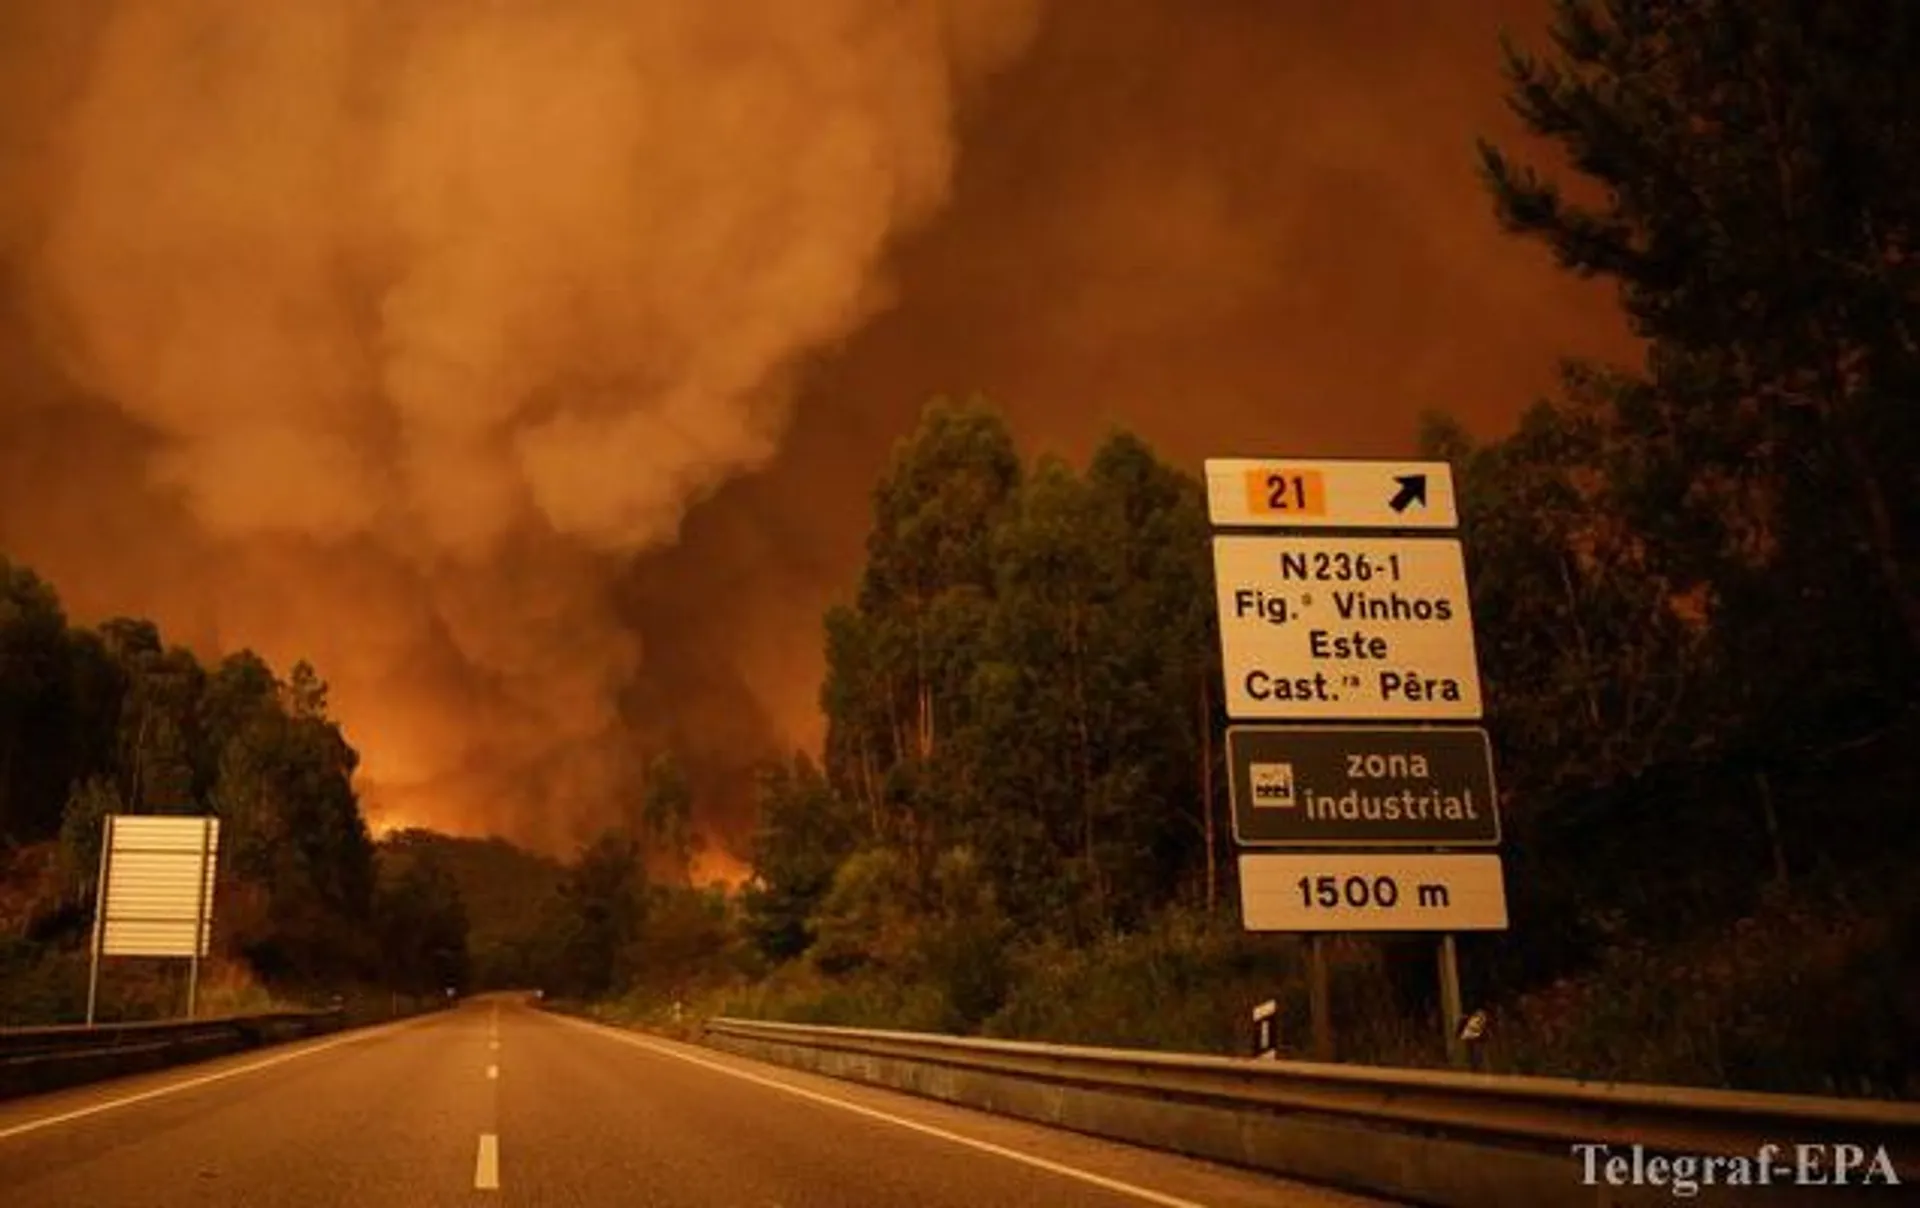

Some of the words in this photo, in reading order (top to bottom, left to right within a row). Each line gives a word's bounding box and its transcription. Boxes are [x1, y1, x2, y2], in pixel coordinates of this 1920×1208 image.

[1267, 475, 1305, 509] 21
[1333, 591, 1453, 621] Vinhos
[1309, 629, 1388, 660] Este
[1379, 671, 1461, 701] Pêra
[1347, 753, 1429, 778] zona
[1304, 788, 1479, 820] industrial
[1297, 876, 1398, 908] 1500
[1417, 883, 1450, 907] m
